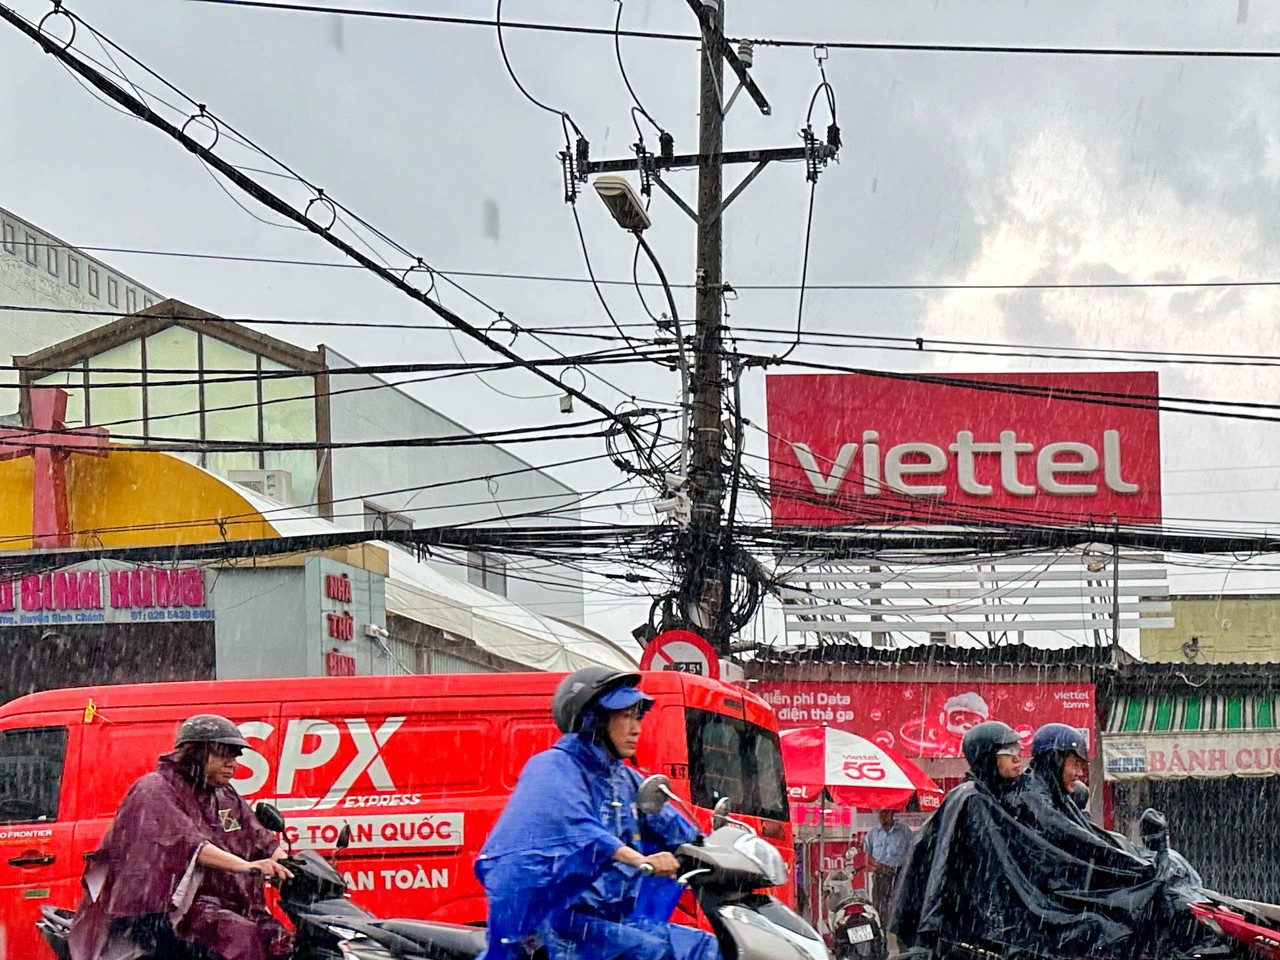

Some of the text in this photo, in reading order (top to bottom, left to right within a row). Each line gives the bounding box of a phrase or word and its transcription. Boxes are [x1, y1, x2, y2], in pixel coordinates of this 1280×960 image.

[793, 429, 1140, 497] viettel
[817, 693, 850, 704] Data
[836, 710, 854, 722] ga
[228, 716, 408, 810] SPX
[1150, 744, 1226, 772] BÁNH
[843, 762, 886, 780] 5G
[343, 793, 422, 808] EXPRESS
[7, 829, 53, 838] FRONTIER
[381, 815, 452, 841] QUỐC
[381, 864, 448, 890] TOÀN
